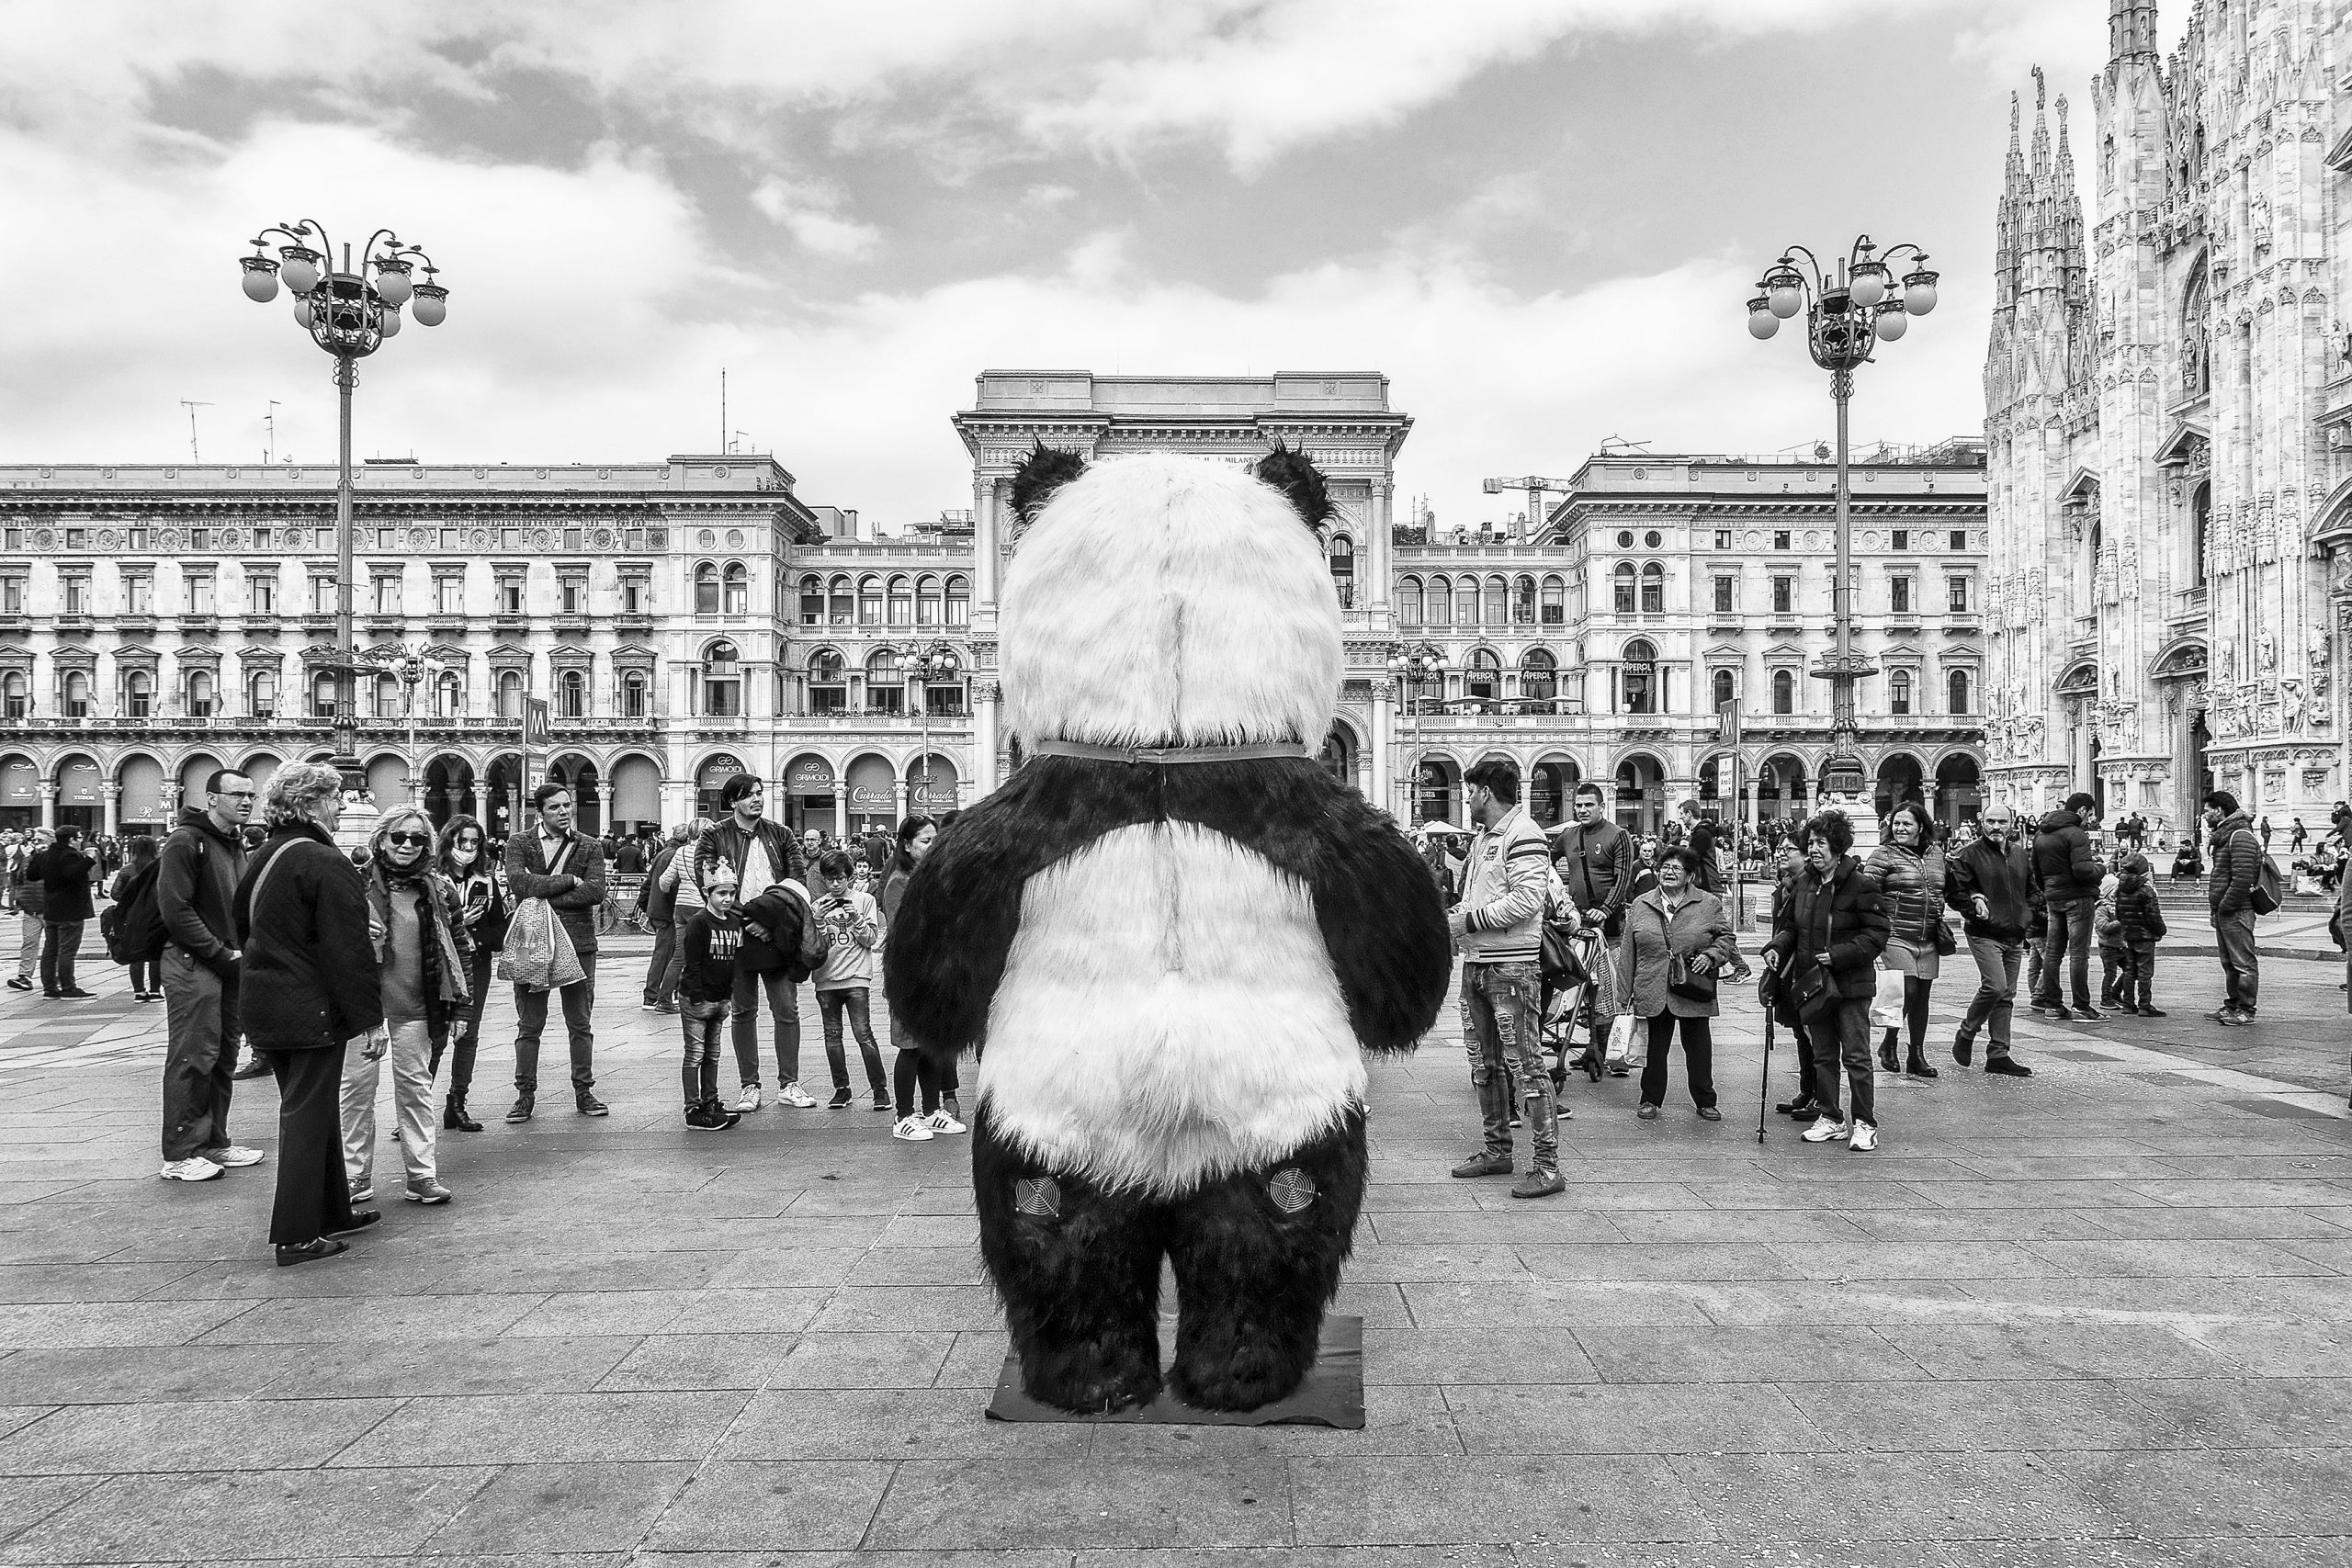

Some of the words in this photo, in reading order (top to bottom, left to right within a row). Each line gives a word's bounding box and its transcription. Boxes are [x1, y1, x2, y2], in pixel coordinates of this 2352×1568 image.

[1623, 661, 1652, 671] APEROL
[1466, 670, 1496, 680] APEROL
[1522, 670, 1552, 680] APEROL
[530, 704, 546, 736] M
[1721, 711, 1734, 736] M
[709, 765, 742, 773] GRIMOLDI
[795, 773, 830, 782] GRIMOLDI
[852, 785, 893, 803] Currado
[913, 786, 955, 802] Crrado
[160, 800, 172, 809] M
[829, 931, 856, 947] BOY
